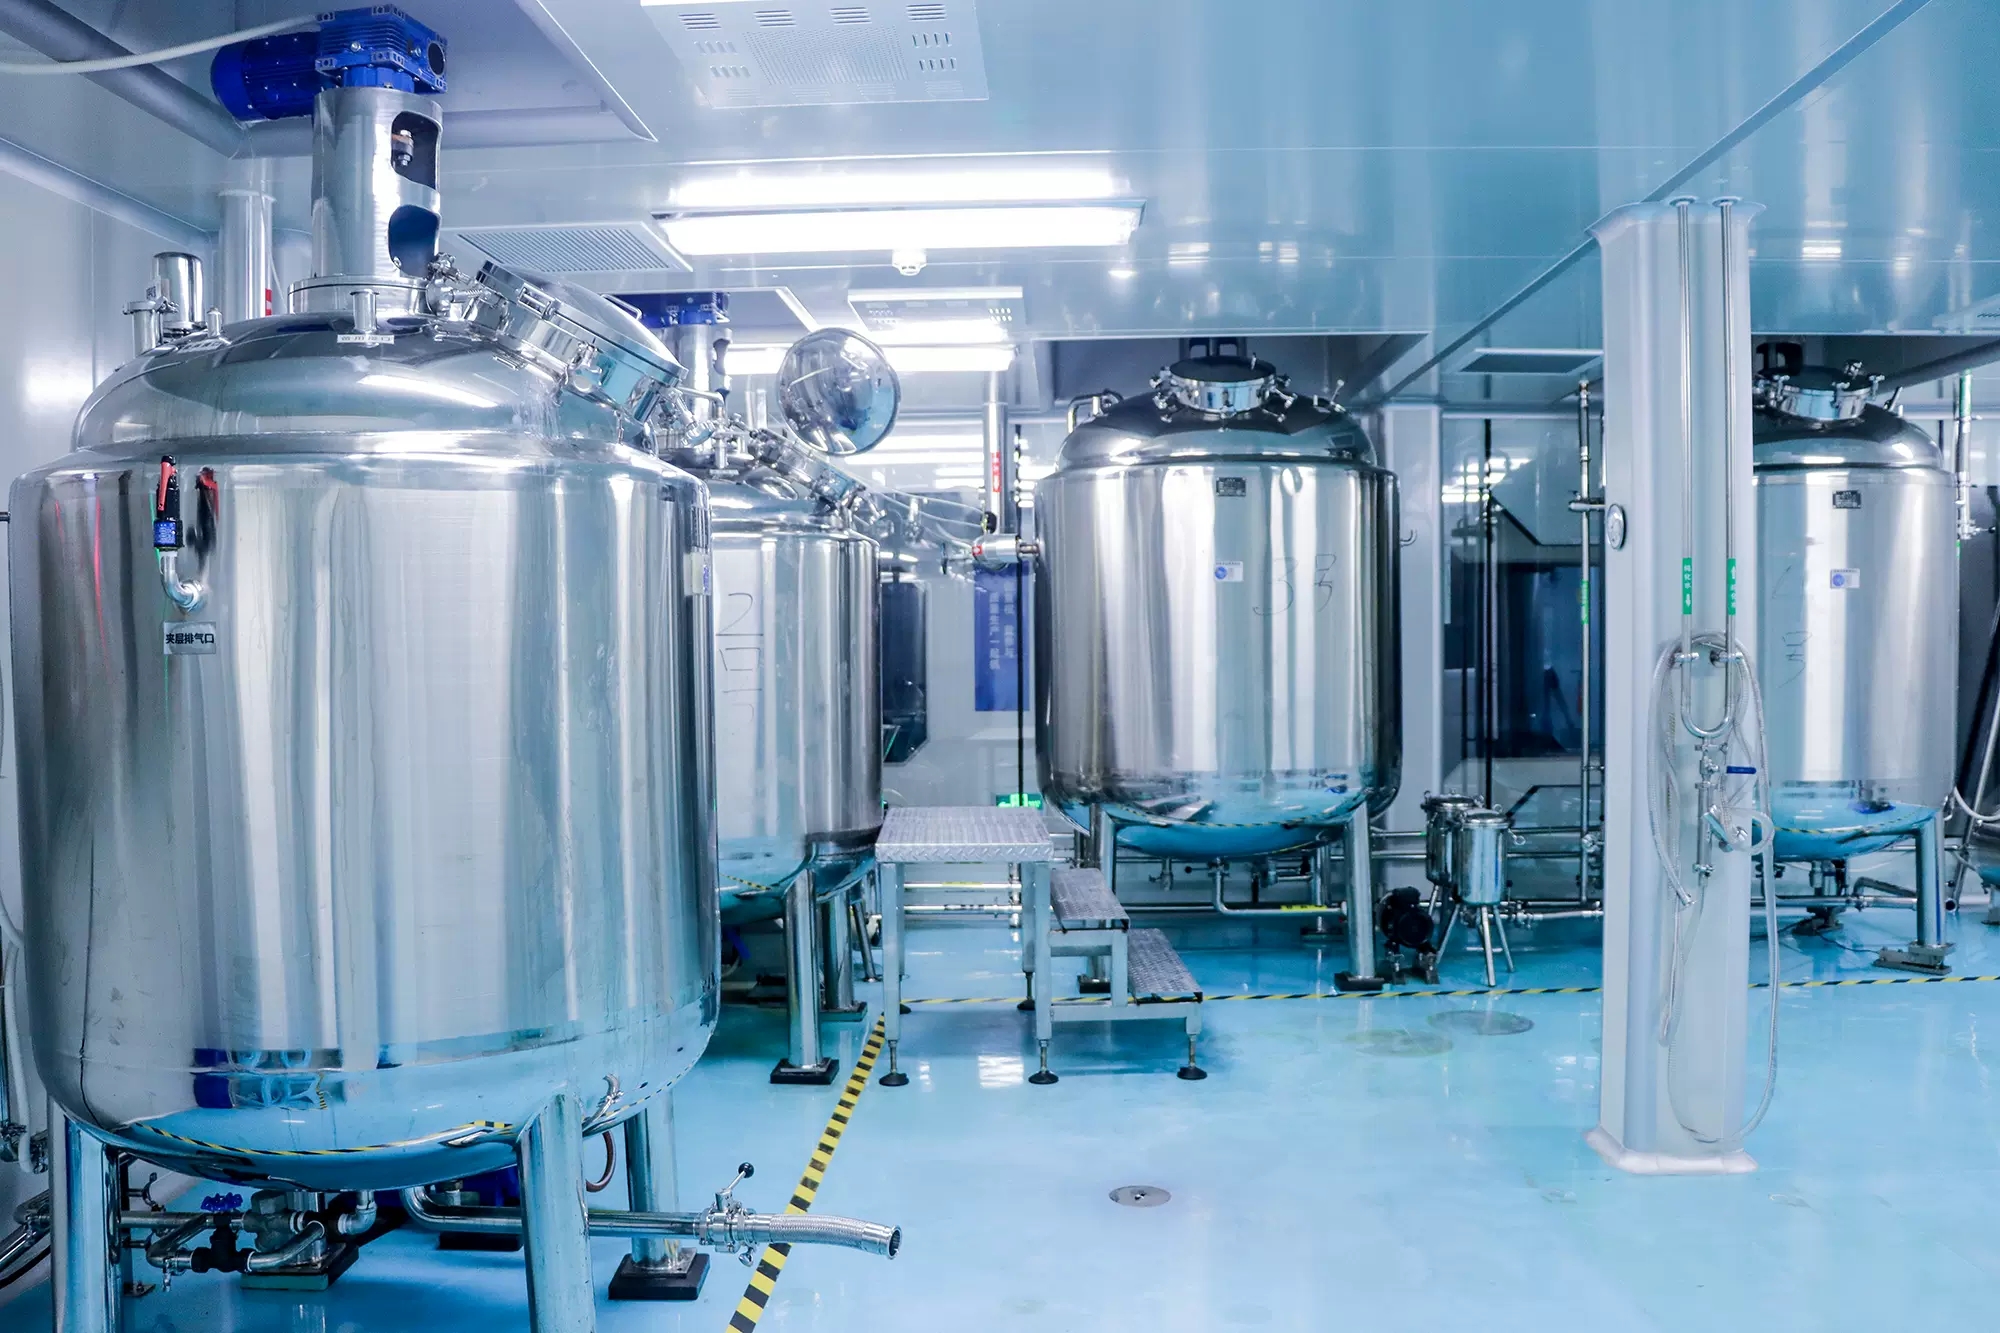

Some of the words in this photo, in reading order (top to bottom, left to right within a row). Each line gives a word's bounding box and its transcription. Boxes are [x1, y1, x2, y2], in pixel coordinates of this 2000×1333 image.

[165, 632, 215, 645] 夹层排气口
